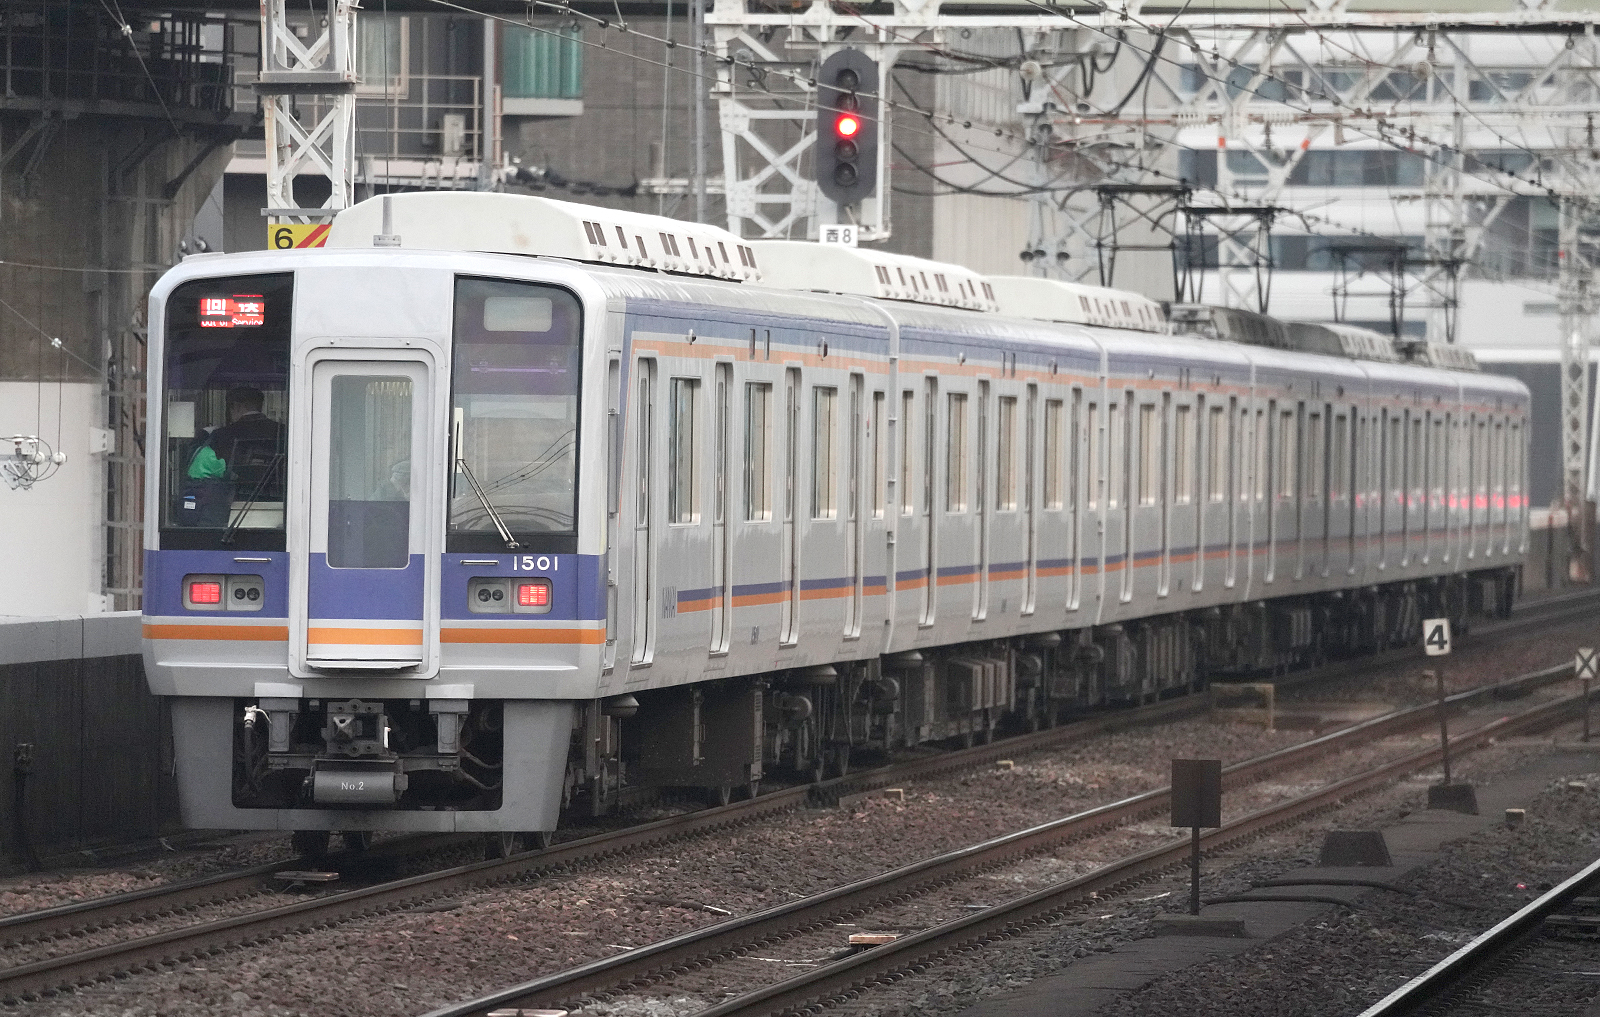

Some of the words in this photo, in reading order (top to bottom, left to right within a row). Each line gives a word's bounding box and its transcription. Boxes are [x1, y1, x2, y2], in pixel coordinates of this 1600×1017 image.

[275, 228, 293, 249] 6
[513, 555, 558, 571] 1501
[1427, 625, 1447, 650] 4
[341, 781, 364, 790] No.2
